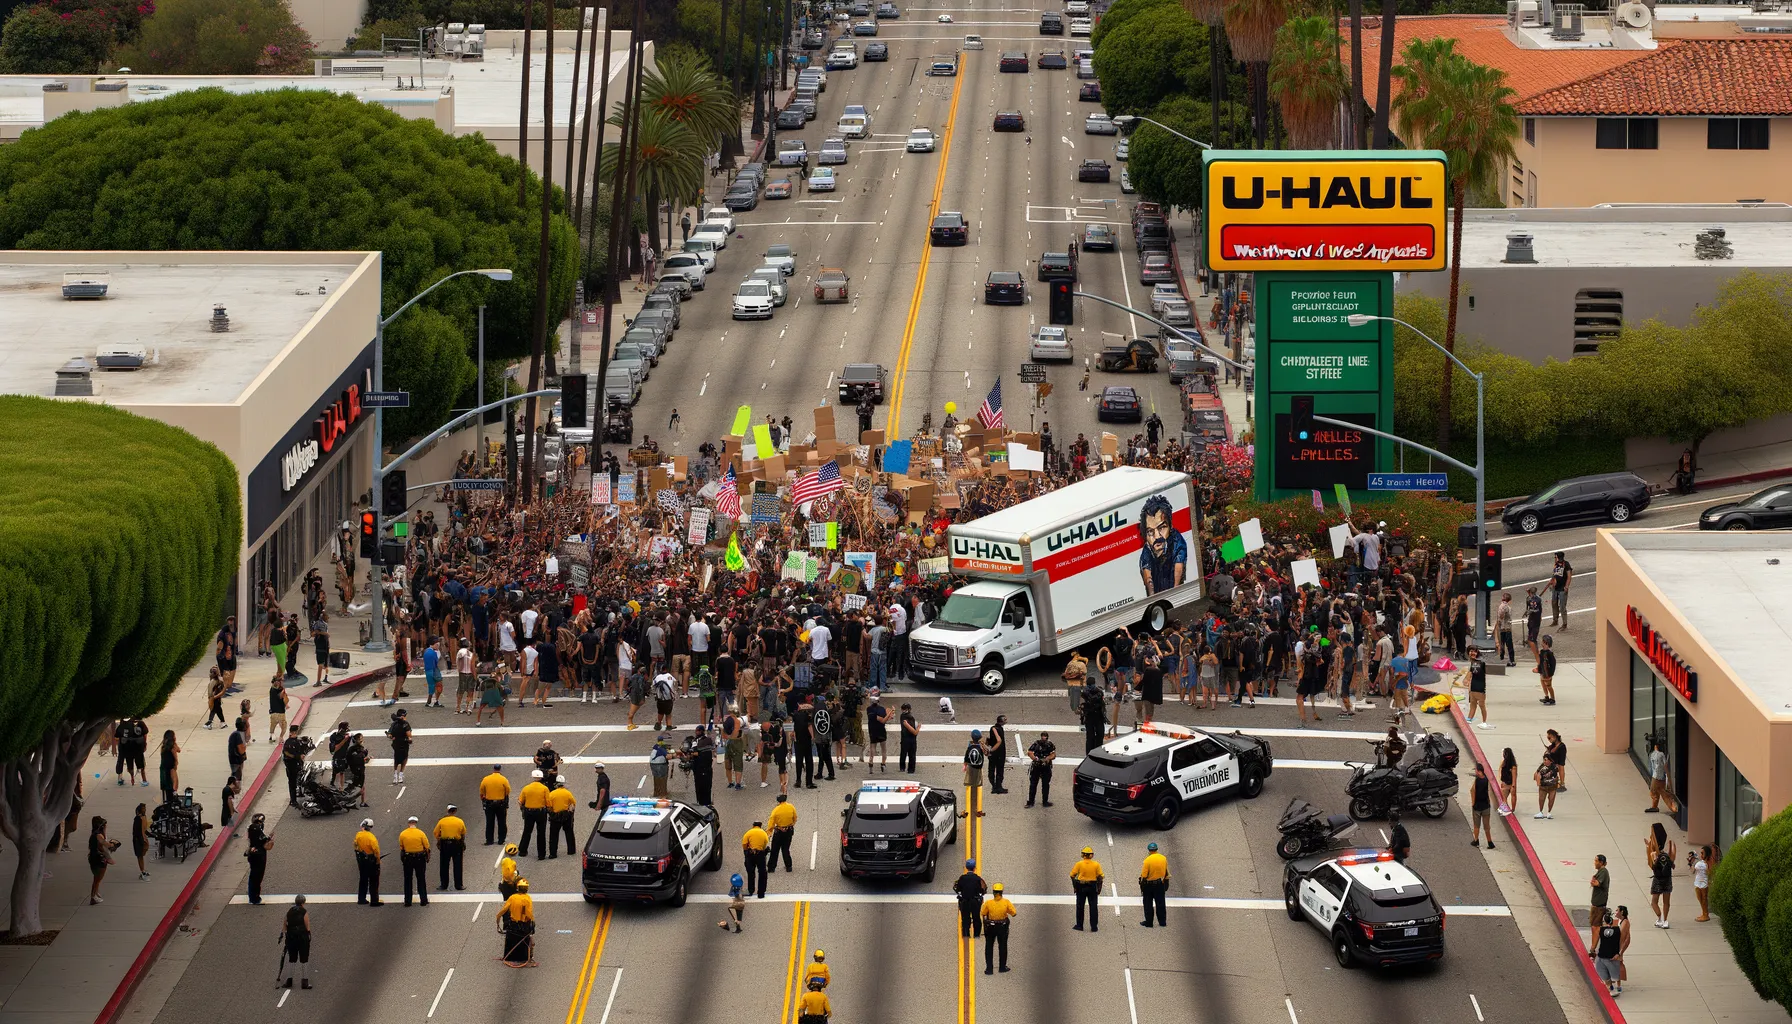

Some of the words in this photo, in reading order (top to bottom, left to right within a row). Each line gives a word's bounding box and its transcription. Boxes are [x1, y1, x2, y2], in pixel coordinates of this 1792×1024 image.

[1222, 176, 1433, 209] U-HAUL
[1047, 510, 1128, 552] U-HAUL
[954, 538, 1020, 562] U-HAL
